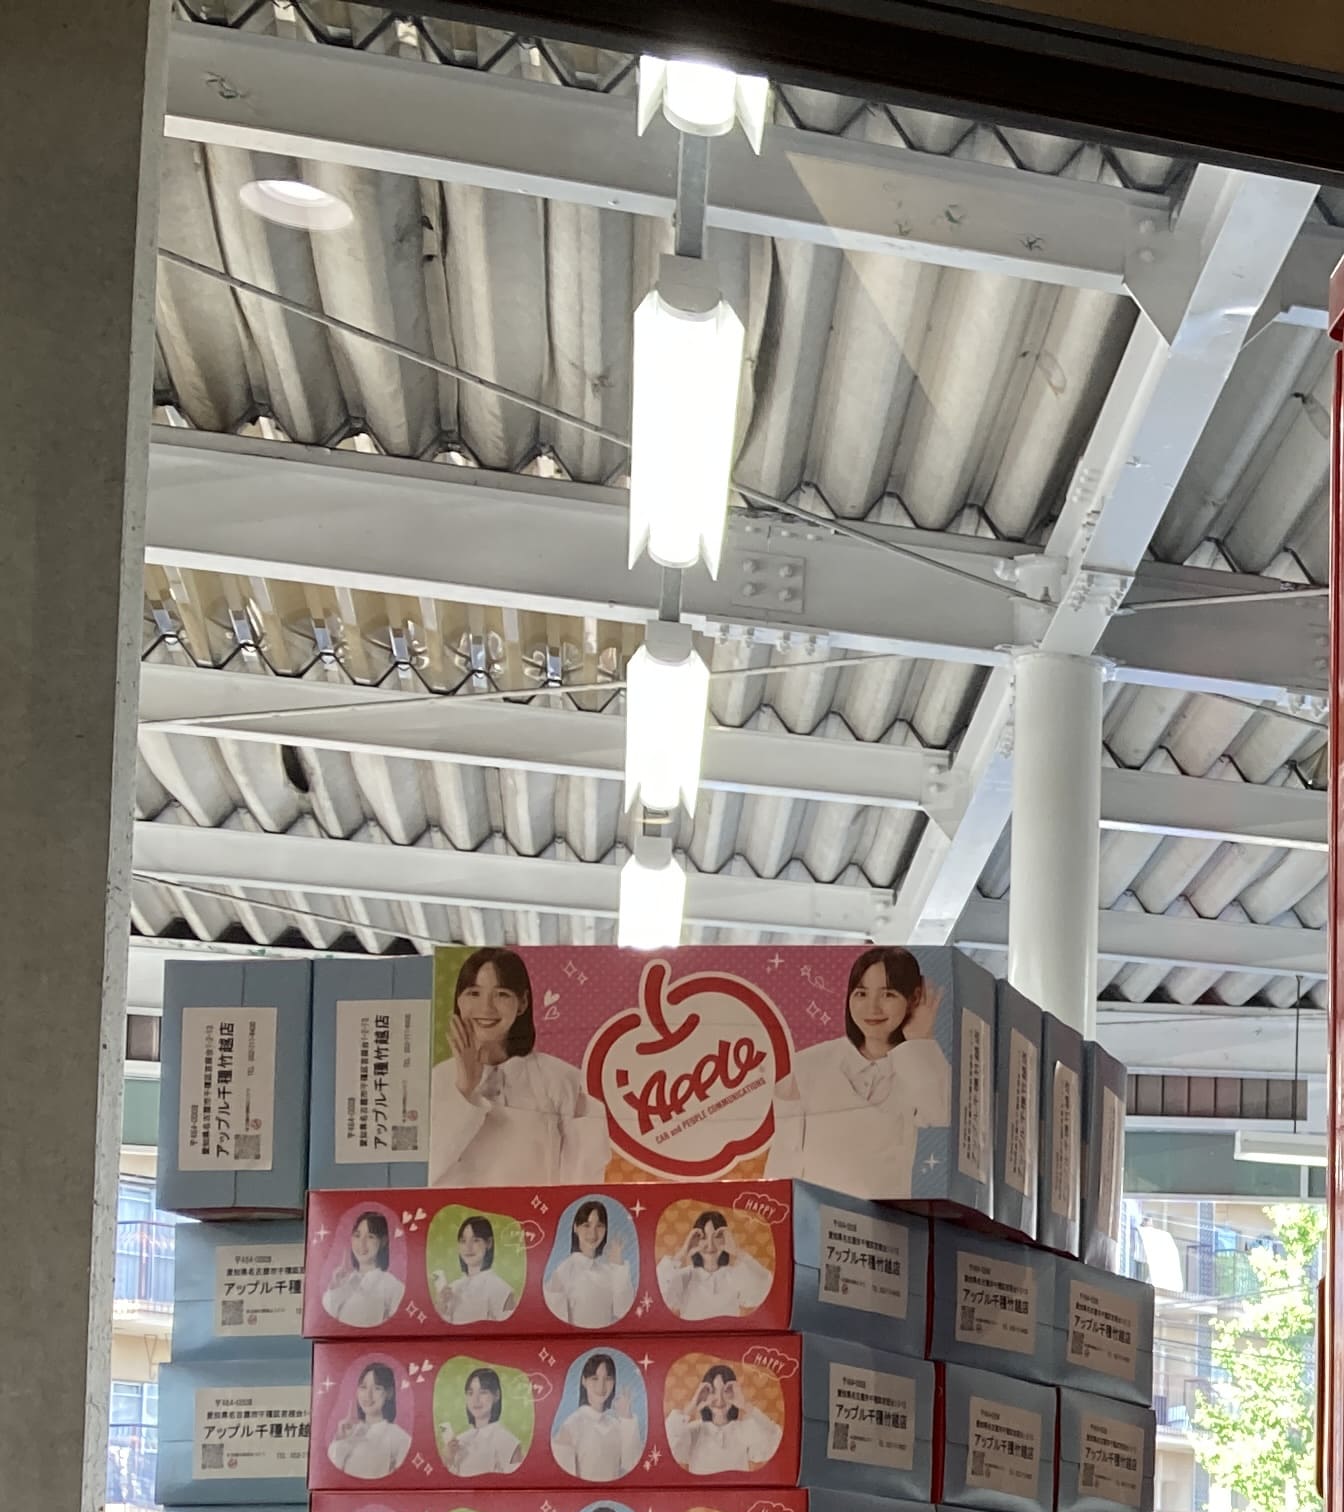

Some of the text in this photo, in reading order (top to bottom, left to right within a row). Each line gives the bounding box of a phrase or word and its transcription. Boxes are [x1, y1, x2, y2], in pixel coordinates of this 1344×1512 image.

[216, 1022, 234, 1158] アップル千種竹越店
[374, 1014, 390, 1150] アップル千種竹越店
[745, 1199, 776, 1219] HAPPY
[755, 1354, 785, 1374] HAPPY
